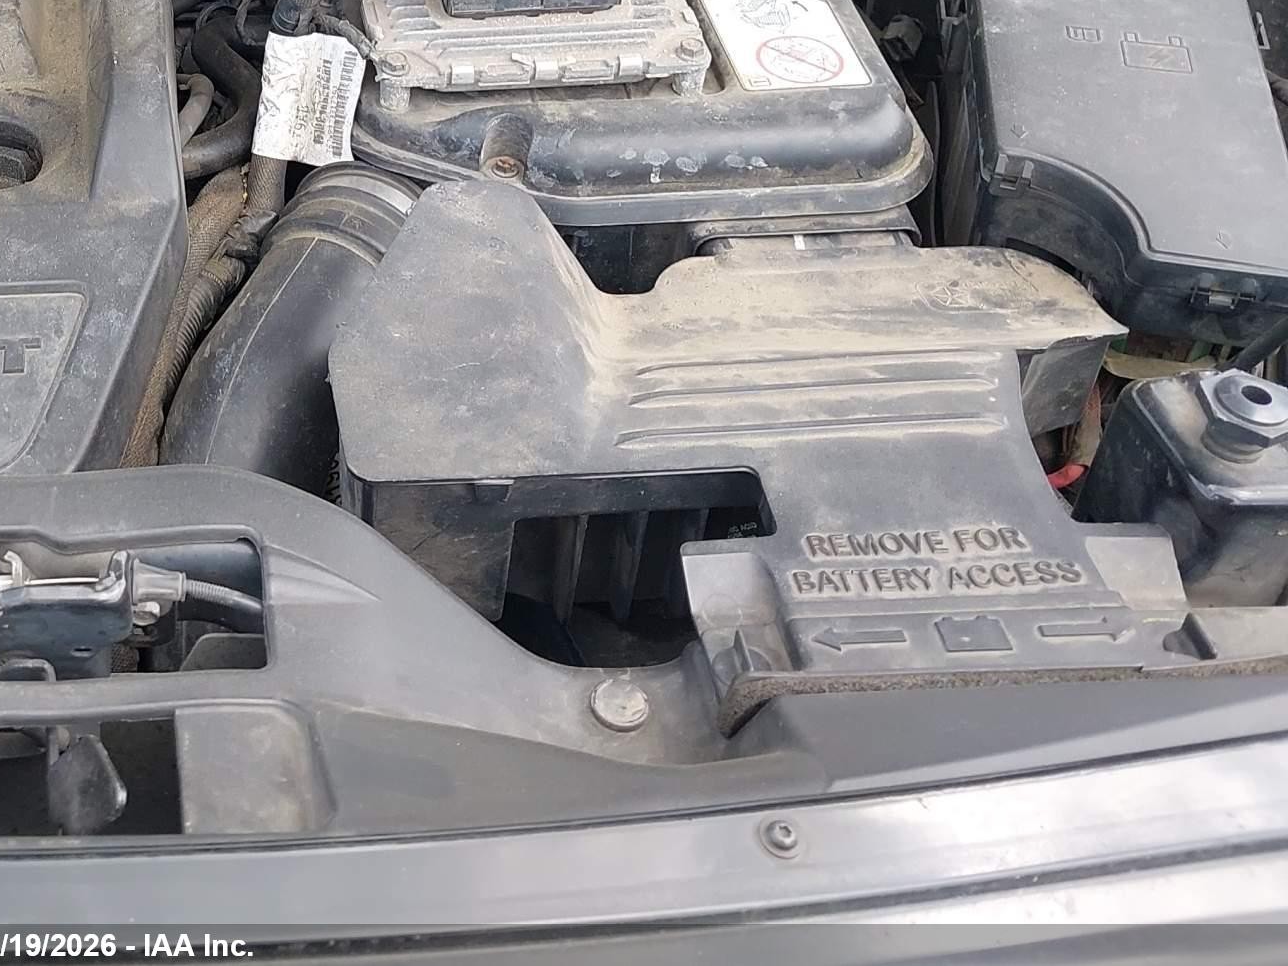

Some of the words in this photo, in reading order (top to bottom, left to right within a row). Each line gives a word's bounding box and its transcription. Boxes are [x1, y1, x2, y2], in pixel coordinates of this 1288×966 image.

[806, 530, 948, 558] REMOVE
[953, 527, 1025, 553] FOR
[793, 567, 933, 594] BATTERY
[948, 560, 1082, 590] ACCESS
